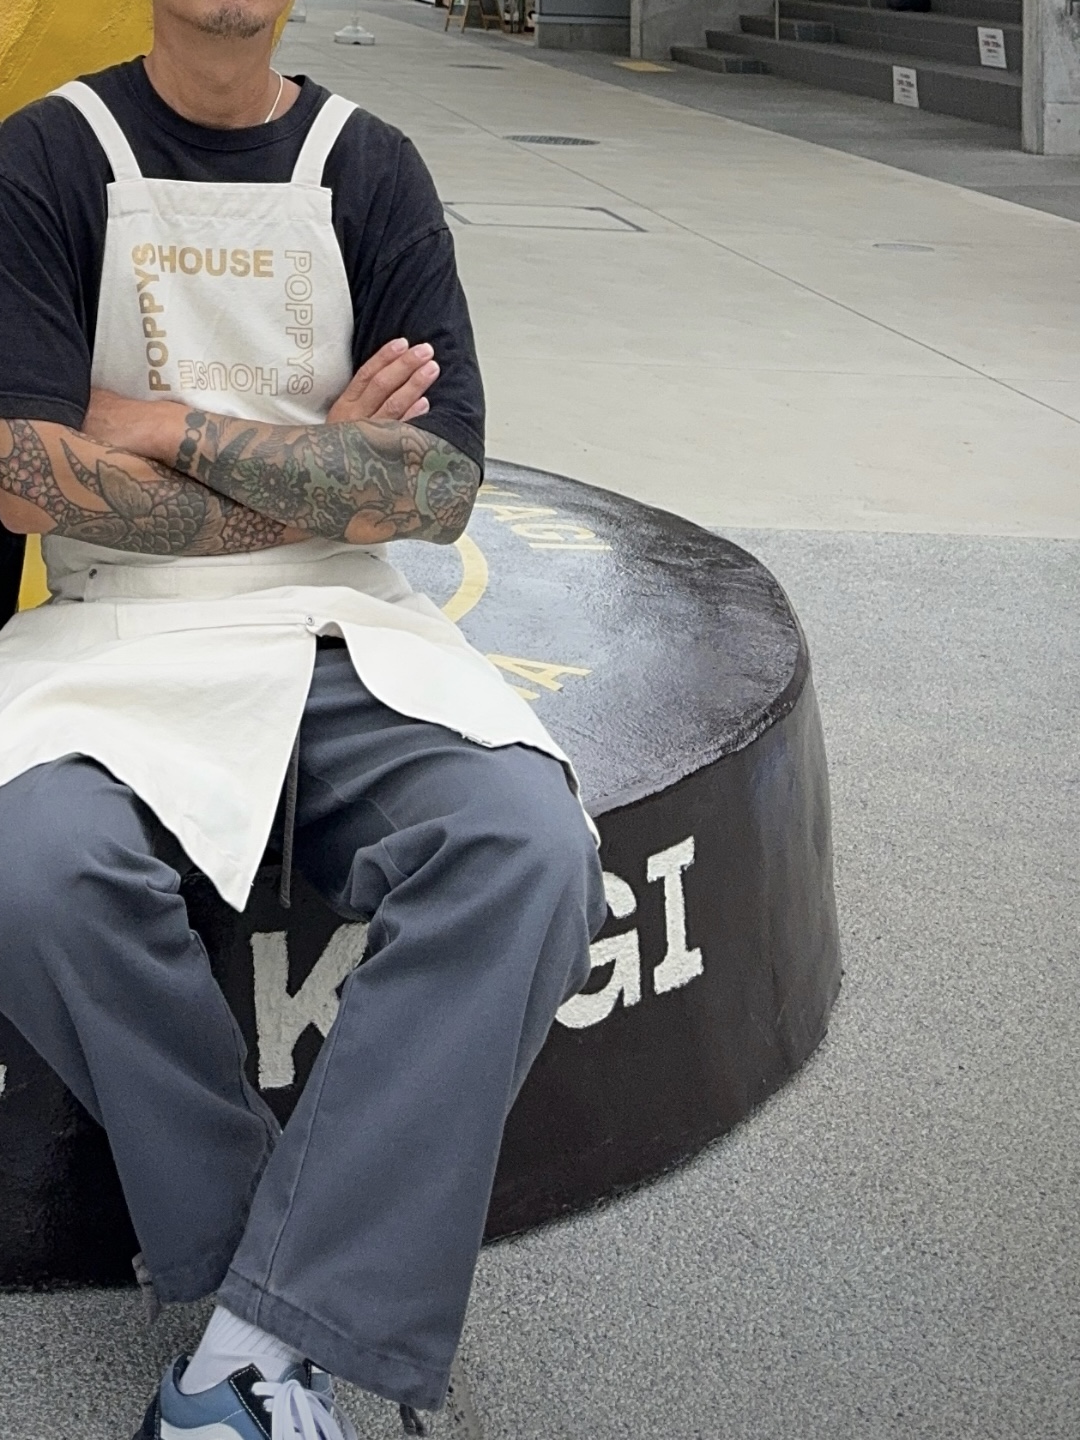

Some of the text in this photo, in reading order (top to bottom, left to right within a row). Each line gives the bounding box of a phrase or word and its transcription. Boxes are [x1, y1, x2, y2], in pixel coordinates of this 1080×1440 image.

[157, 245, 274, 278] HOUSE
[131, 242, 172, 392] POPPYS
[284, 249, 315, 396] POPPYS
[177, 359, 279, 397] HOUSE
